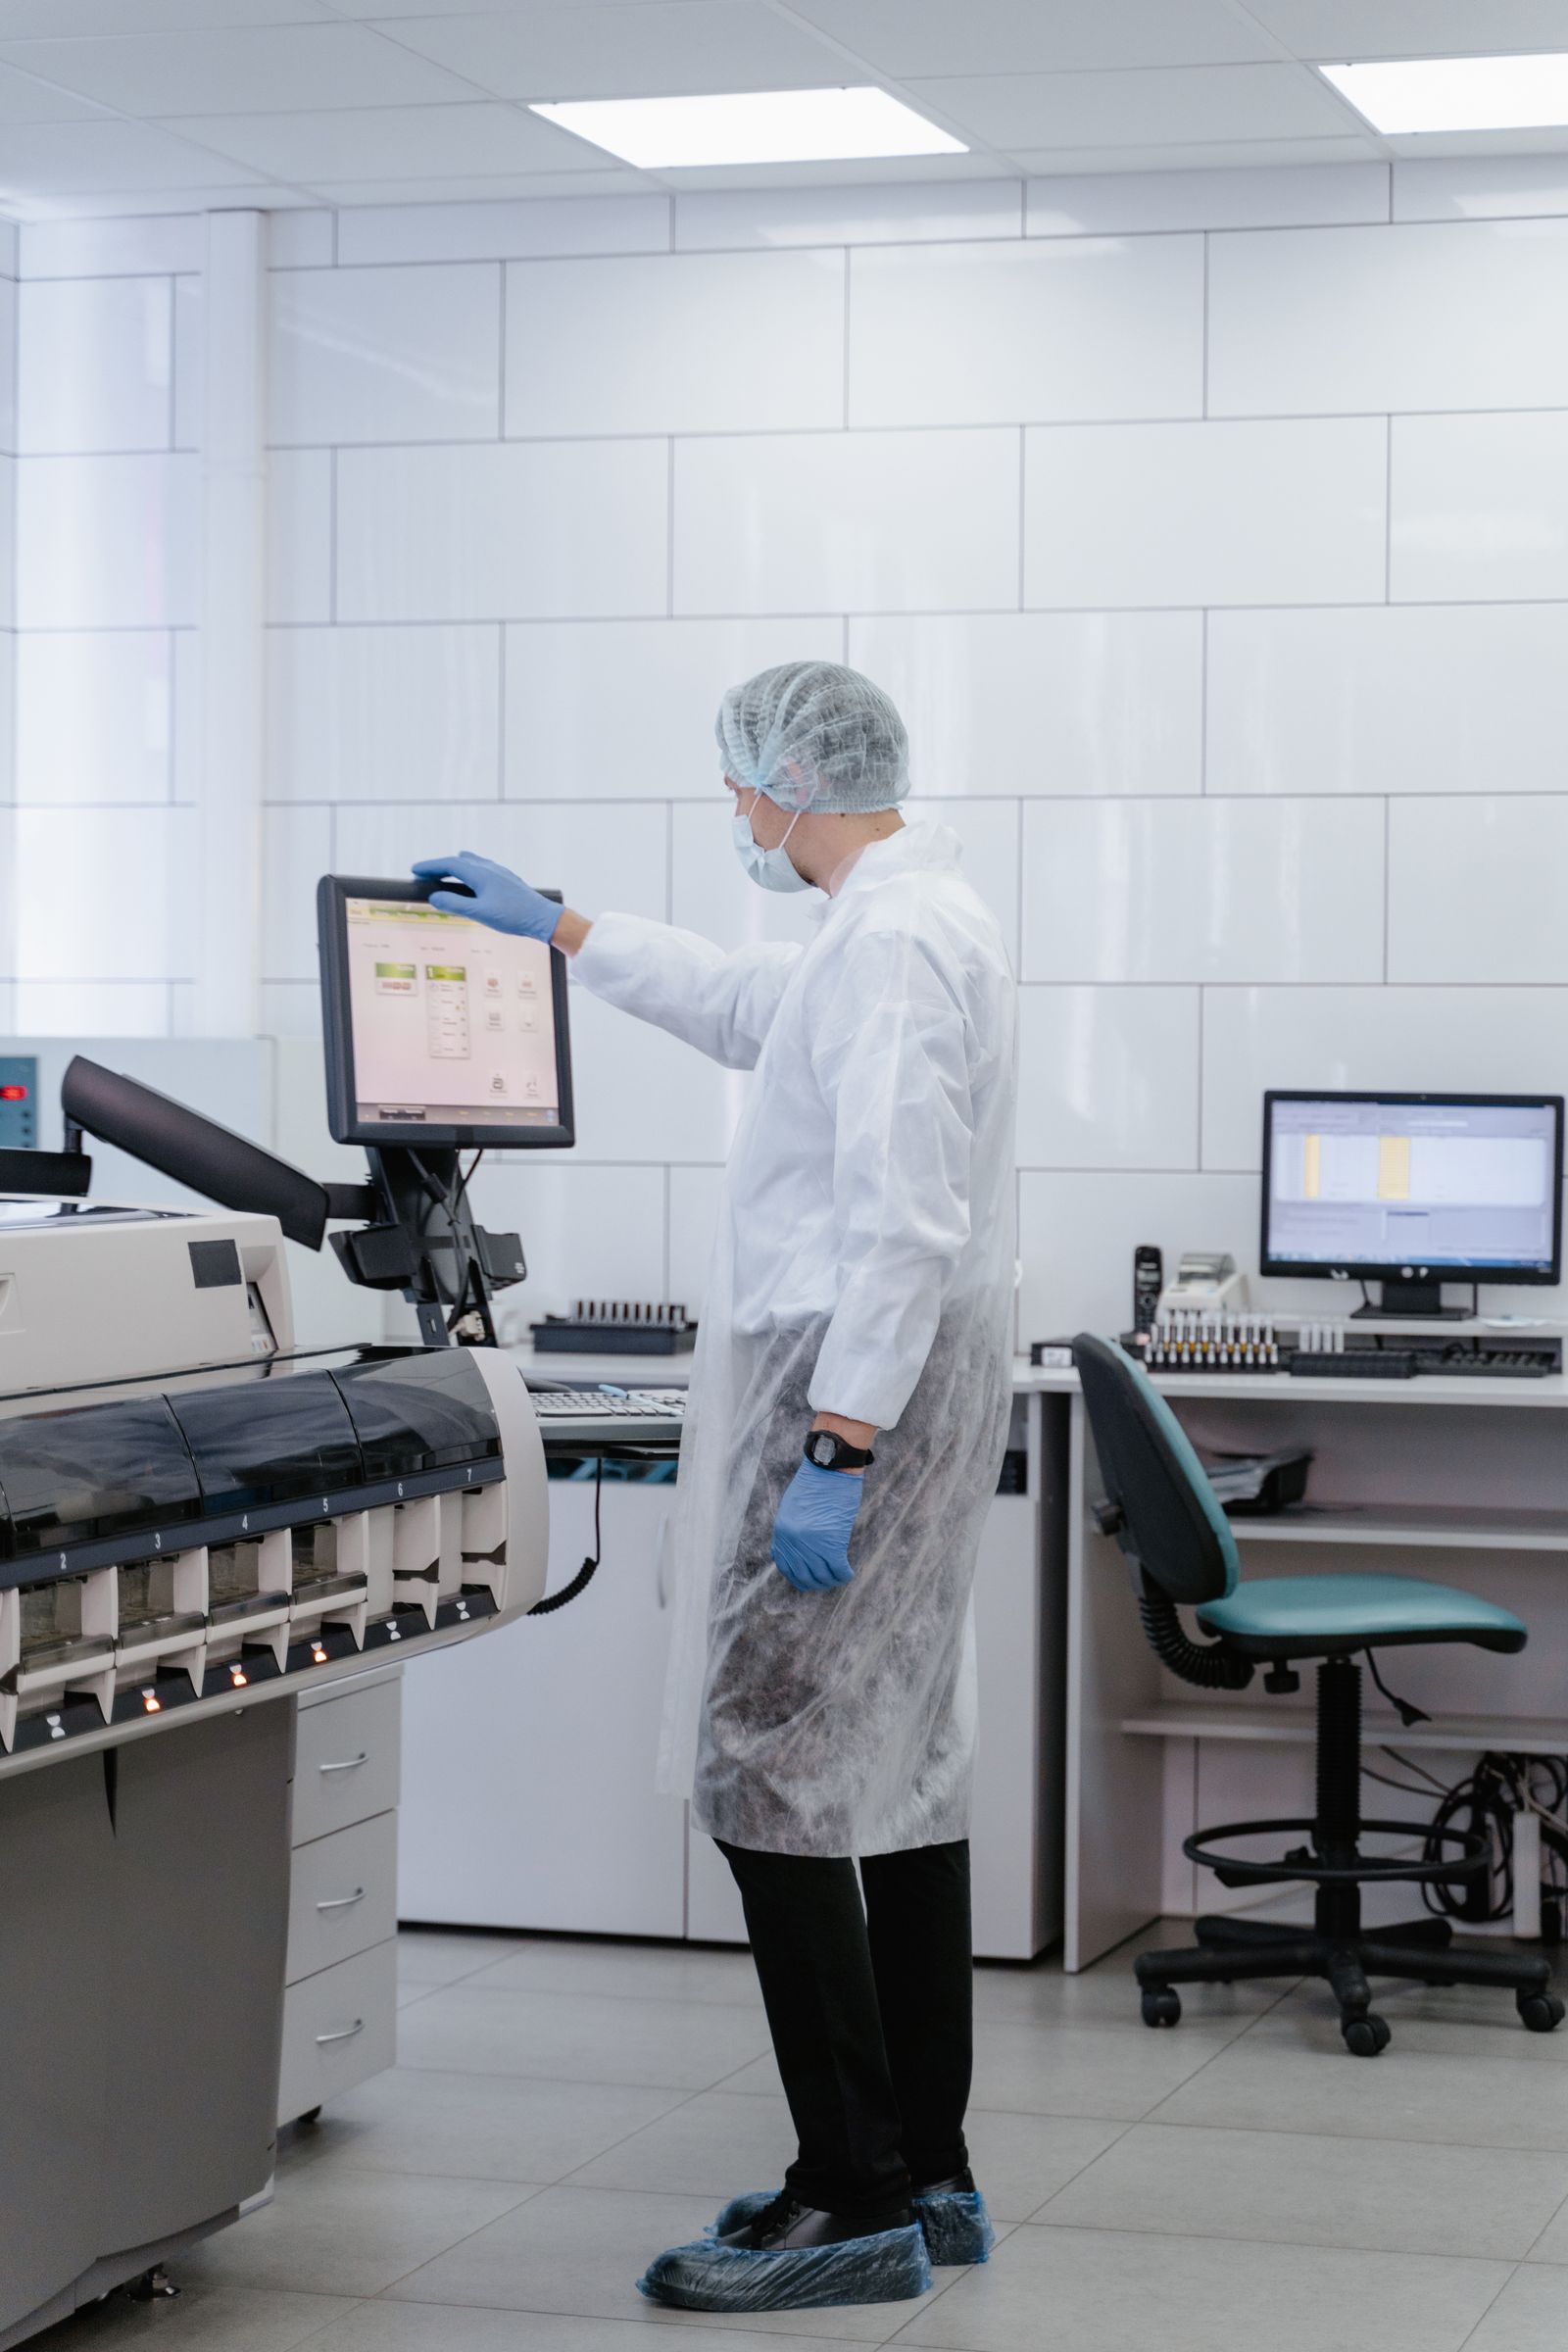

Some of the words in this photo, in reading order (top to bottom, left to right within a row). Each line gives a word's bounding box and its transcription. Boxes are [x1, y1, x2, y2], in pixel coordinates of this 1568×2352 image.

[60, 1553, 67, 1570] 2
[155, 1534, 162, 1549] 3
[241, 1515, 249, 1530] 4
[322, 1497, 329, 1513] 5
[397, 1482, 404, 1496] 6
[466, 1468, 472, 1482] 7
